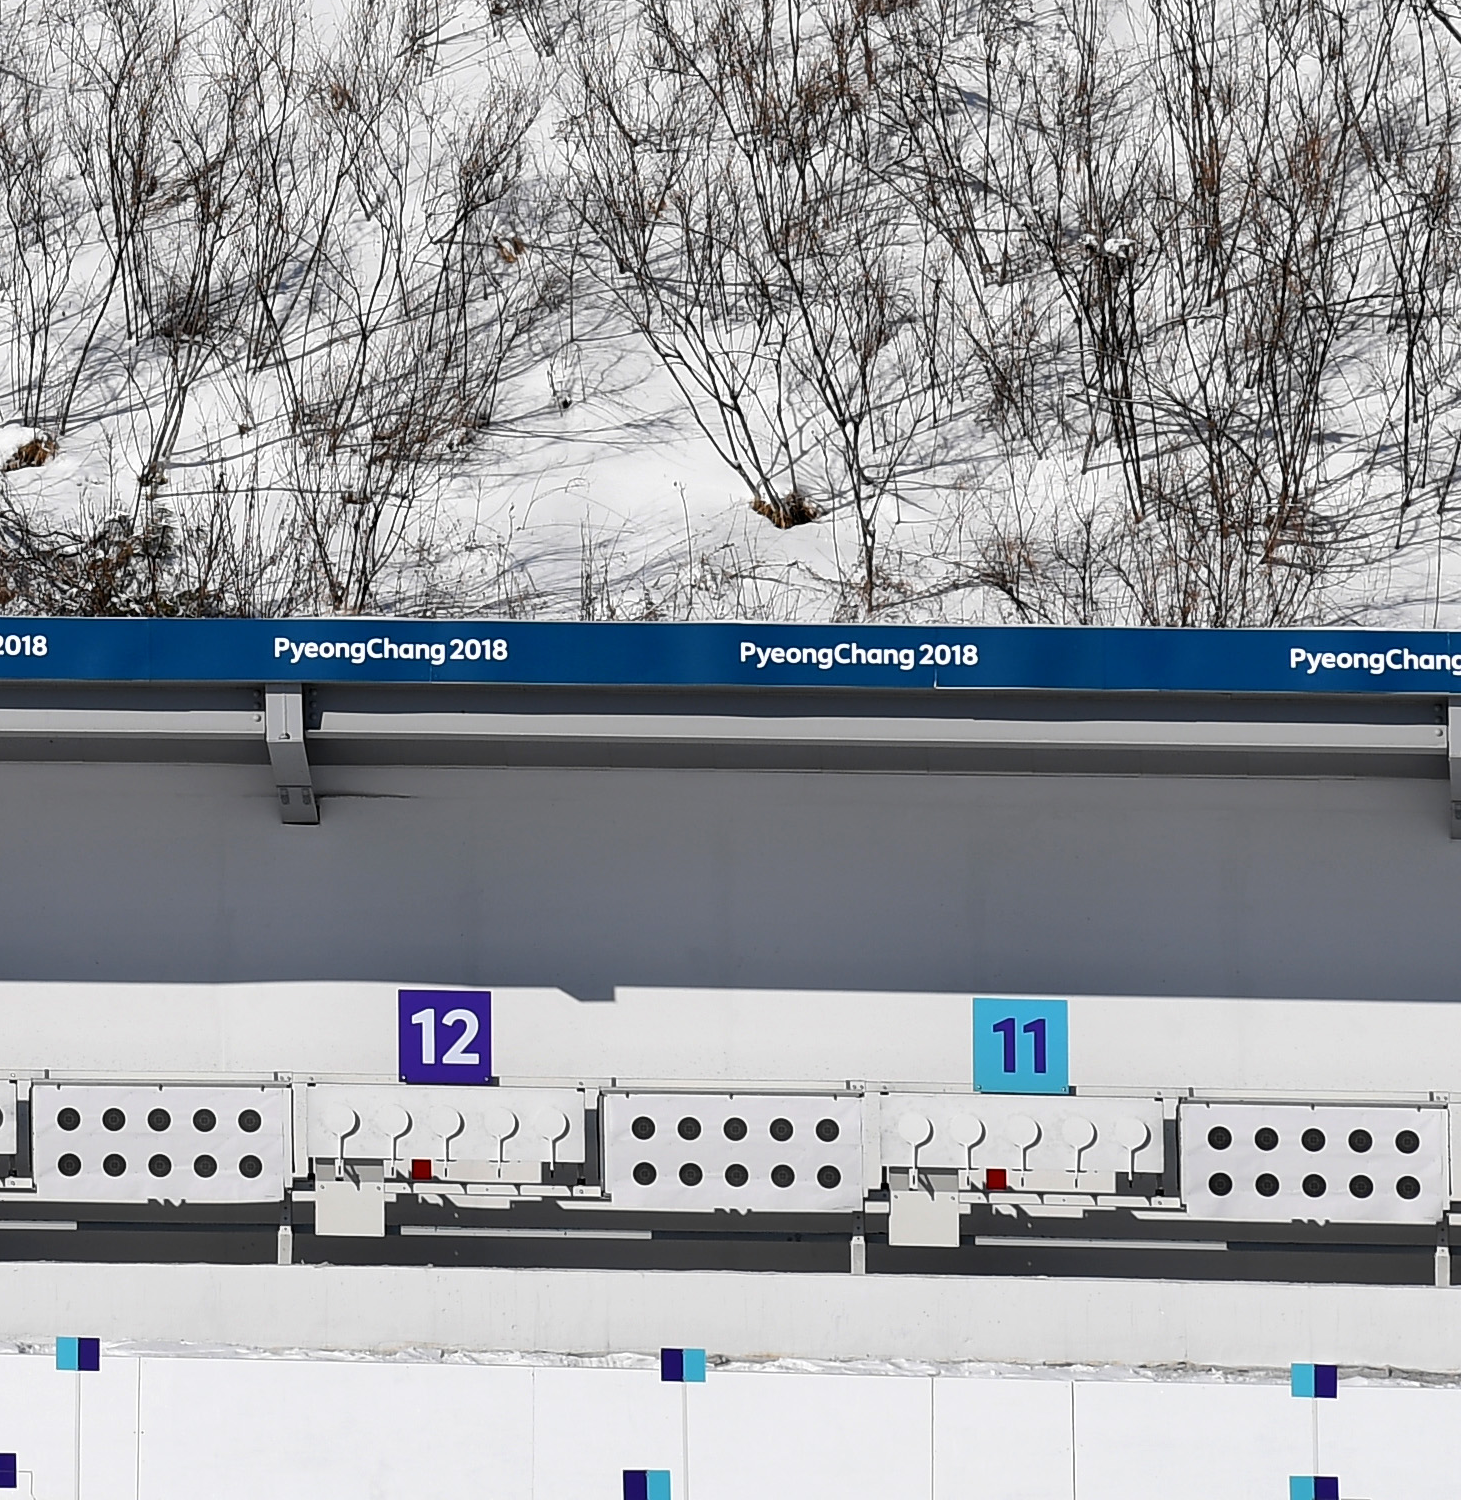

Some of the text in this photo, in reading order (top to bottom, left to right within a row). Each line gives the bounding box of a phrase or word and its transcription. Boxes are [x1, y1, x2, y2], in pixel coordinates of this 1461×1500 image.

[275, 638, 507, 665] PyeongChang 2018
[741, 642, 978, 670] PyeongChang 2018
[411, 1008, 481, 1065] 12
[992, 1017, 1047, 1074] 11
